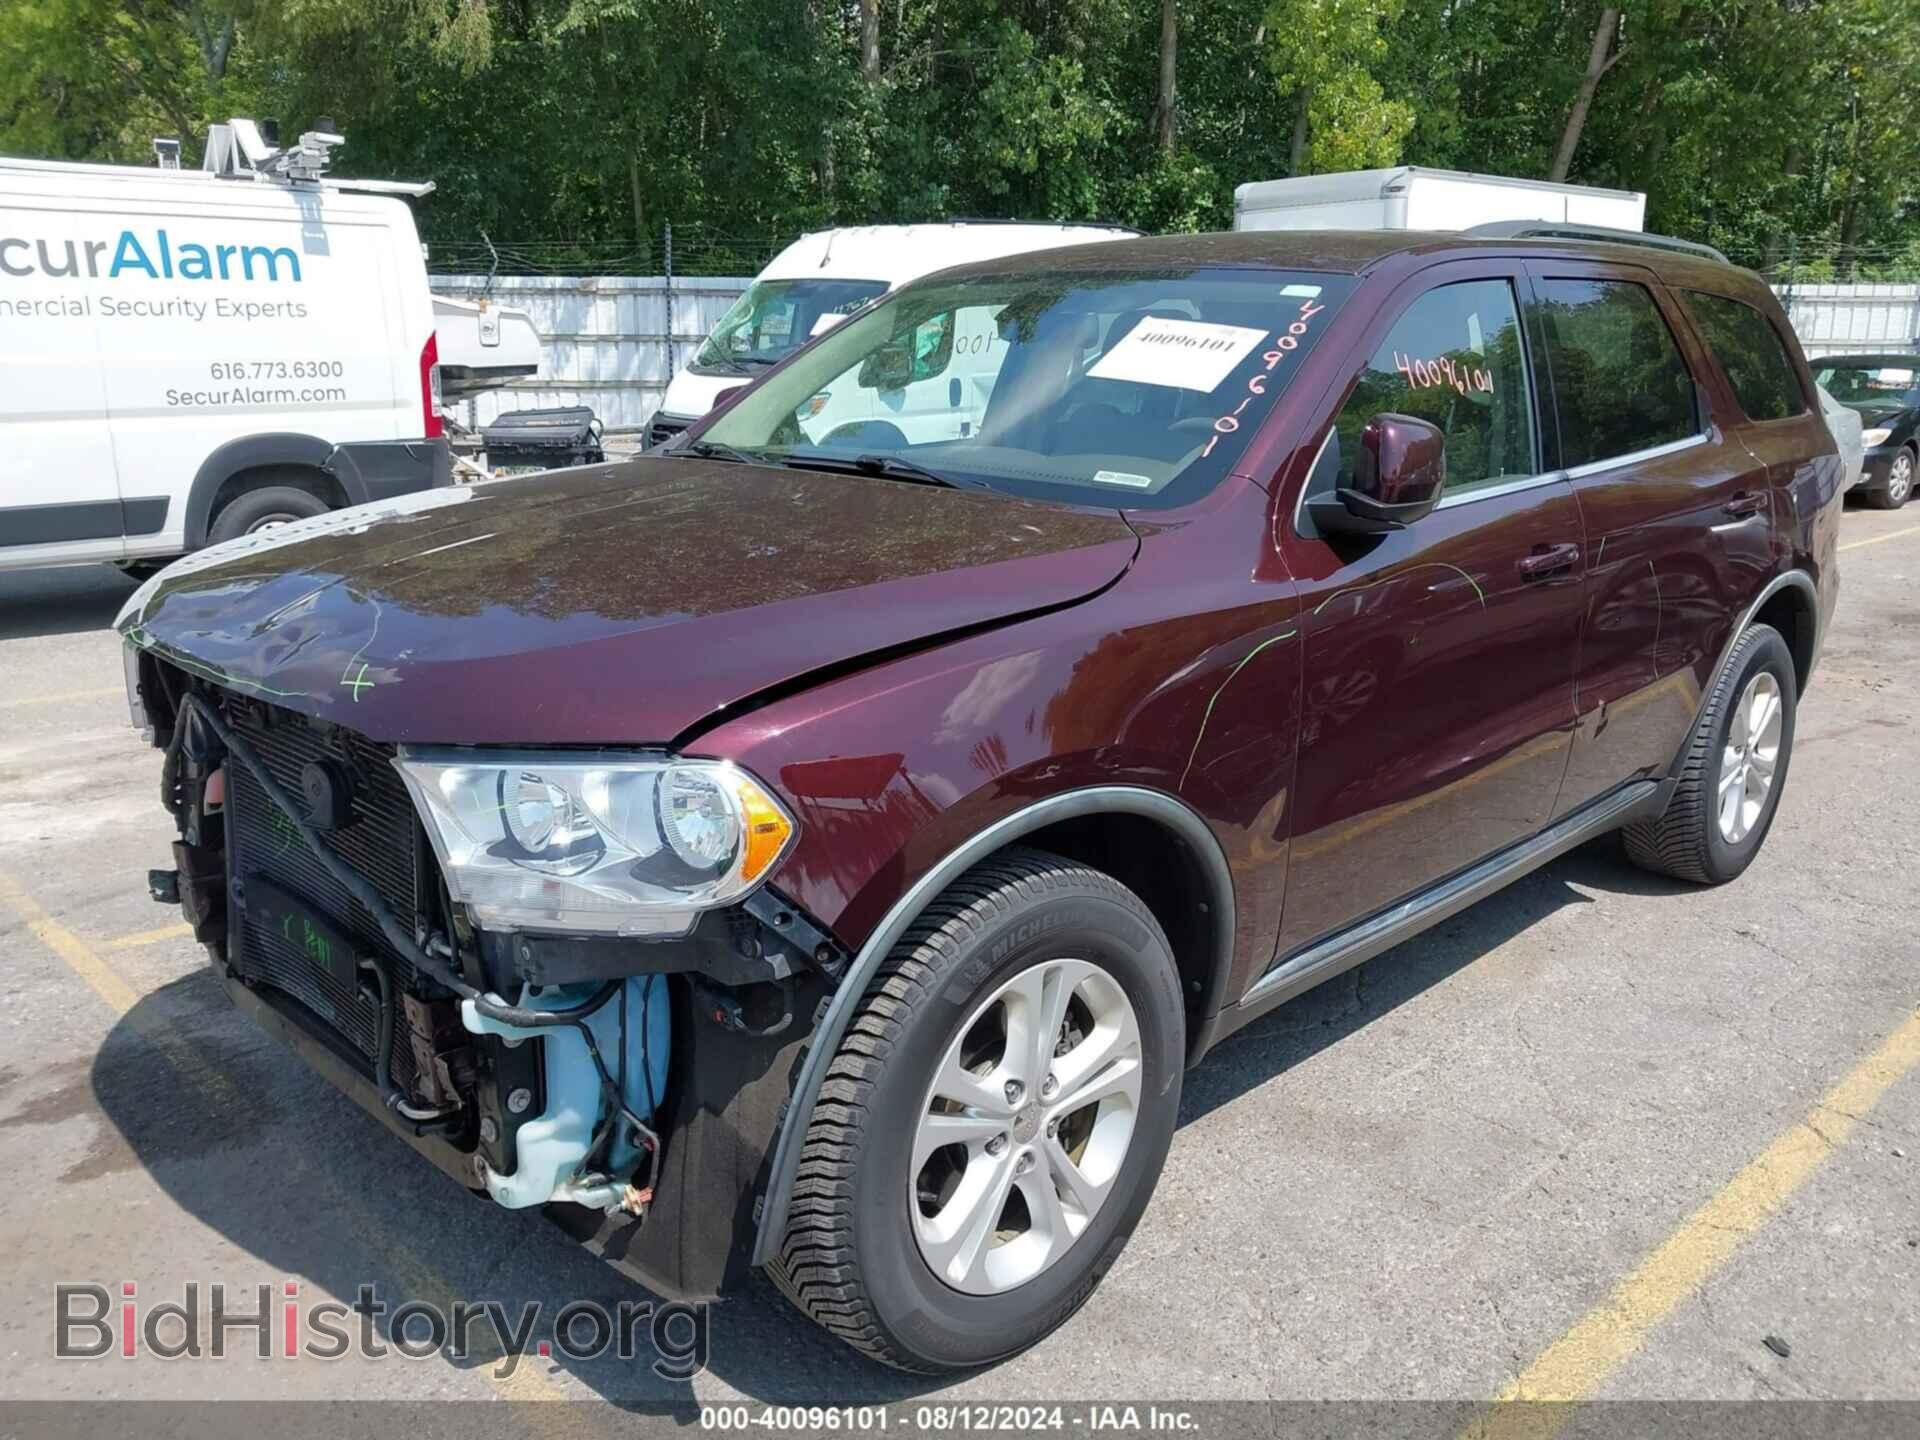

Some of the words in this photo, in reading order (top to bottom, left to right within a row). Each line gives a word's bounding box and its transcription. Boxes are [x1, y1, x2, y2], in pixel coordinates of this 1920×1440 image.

[99, 296, 207, 321] Security
[215, 298, 308, 321] Experts
[210, 361, 343, 380] 616.773.6300
[166, 387, 346, 406] SecurAlarm.com
